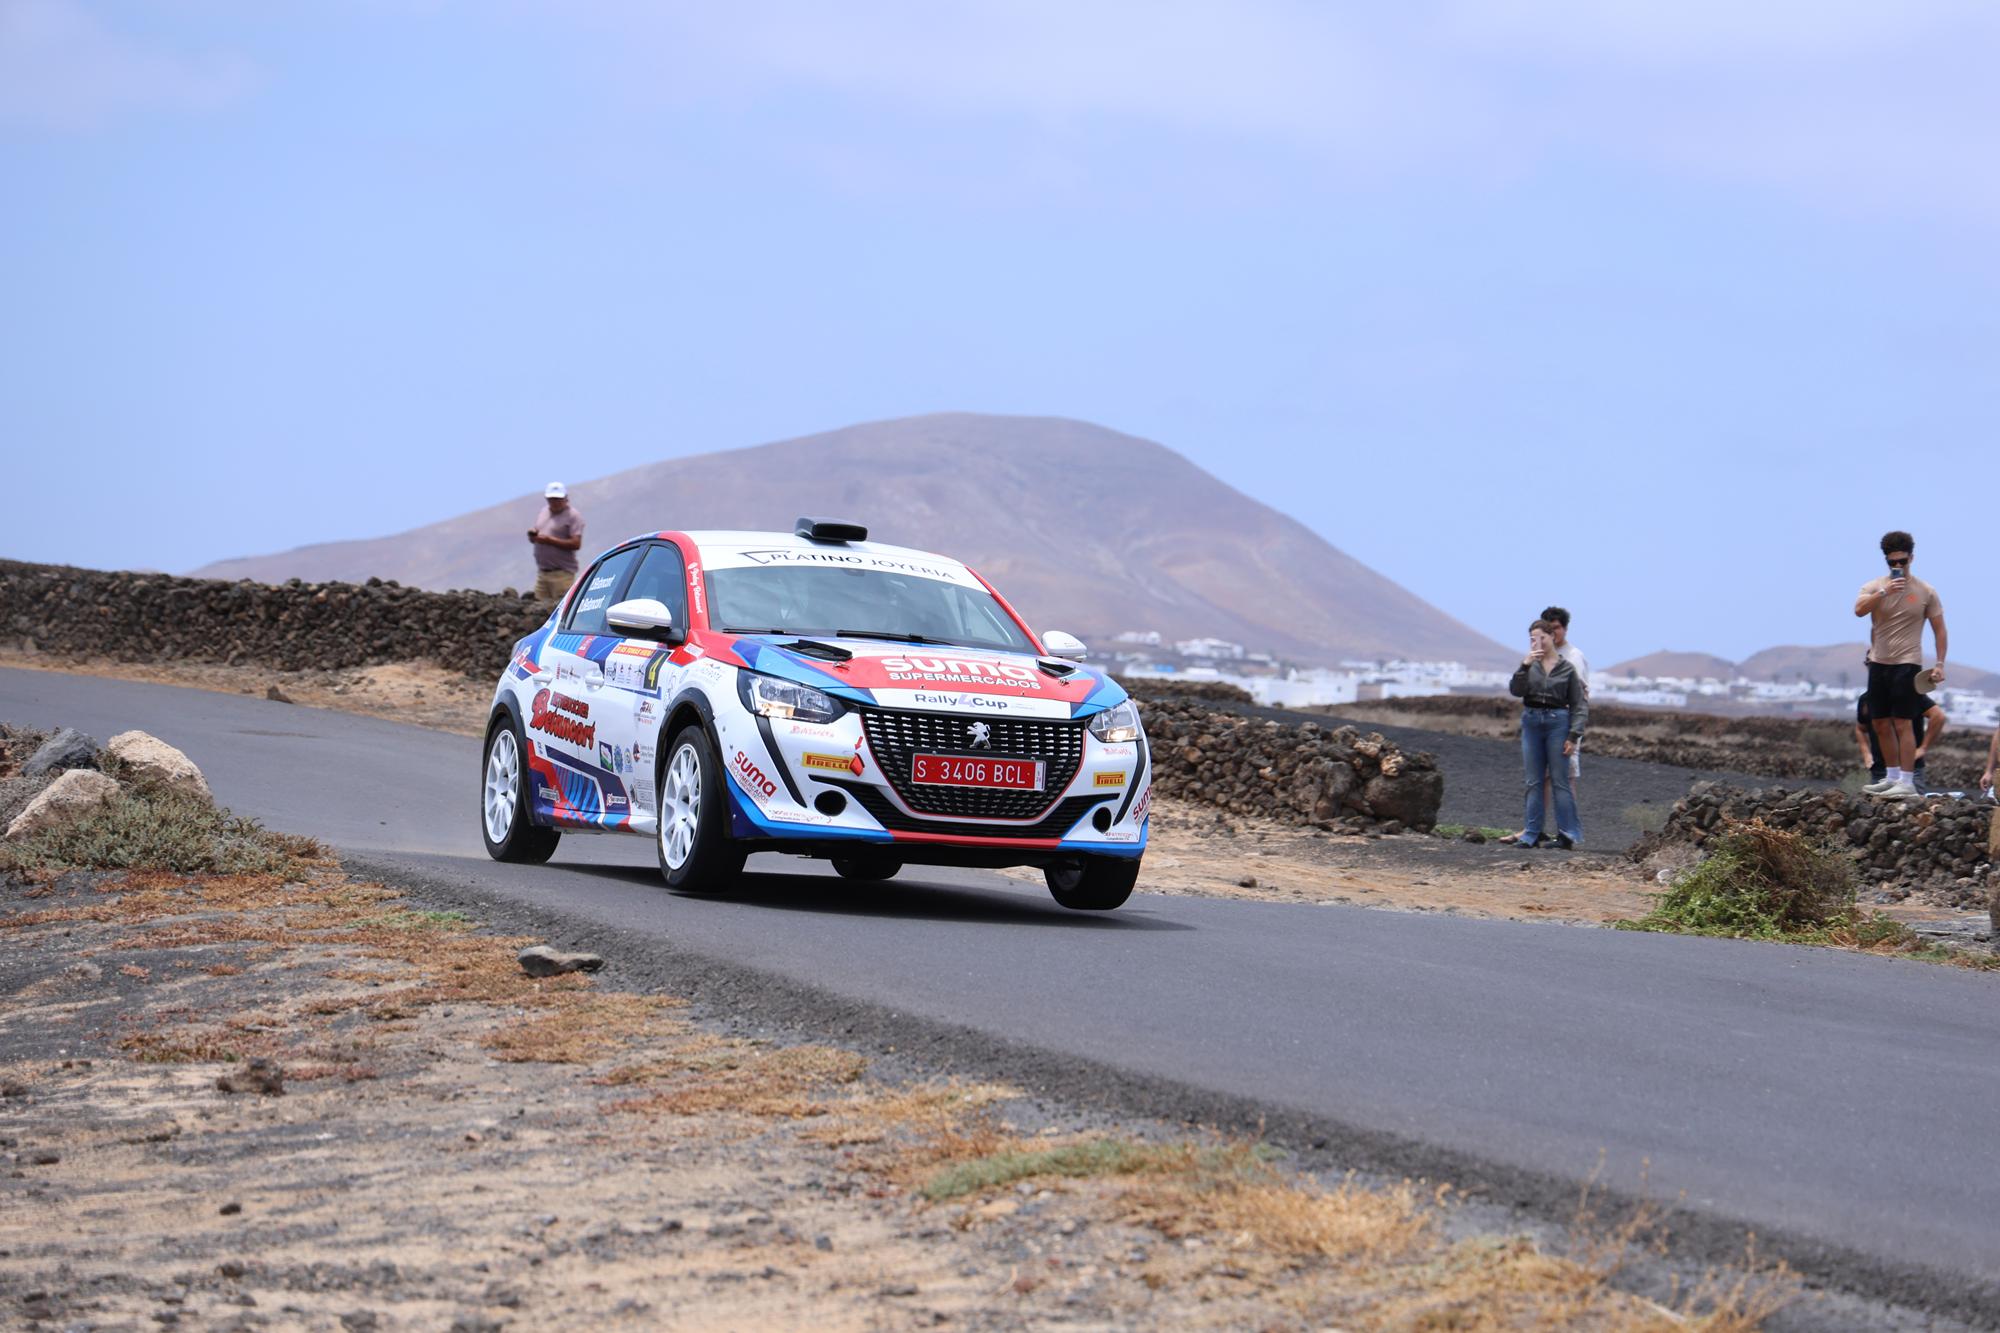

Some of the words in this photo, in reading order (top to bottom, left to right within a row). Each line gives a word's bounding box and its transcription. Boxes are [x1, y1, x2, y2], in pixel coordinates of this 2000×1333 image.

[770, 553, 863, 564] PLATINO
[871, 559, 957, 580] JOYERIA
[648, 652, 665, 687] 4
[880, 657, 1038, 682] suma
[889, 671, 1041, 690] SUPERMERCADOS
[734, 750, 778, 798] suma
[805, 754, 849, 770] PIRELLI
[916, 760, 927, 778] S
[940, 761, 986, 782] 3406
[993, 764, 1026, 784] BCL
[1096, 773, 1123, 785] PIRELLI
